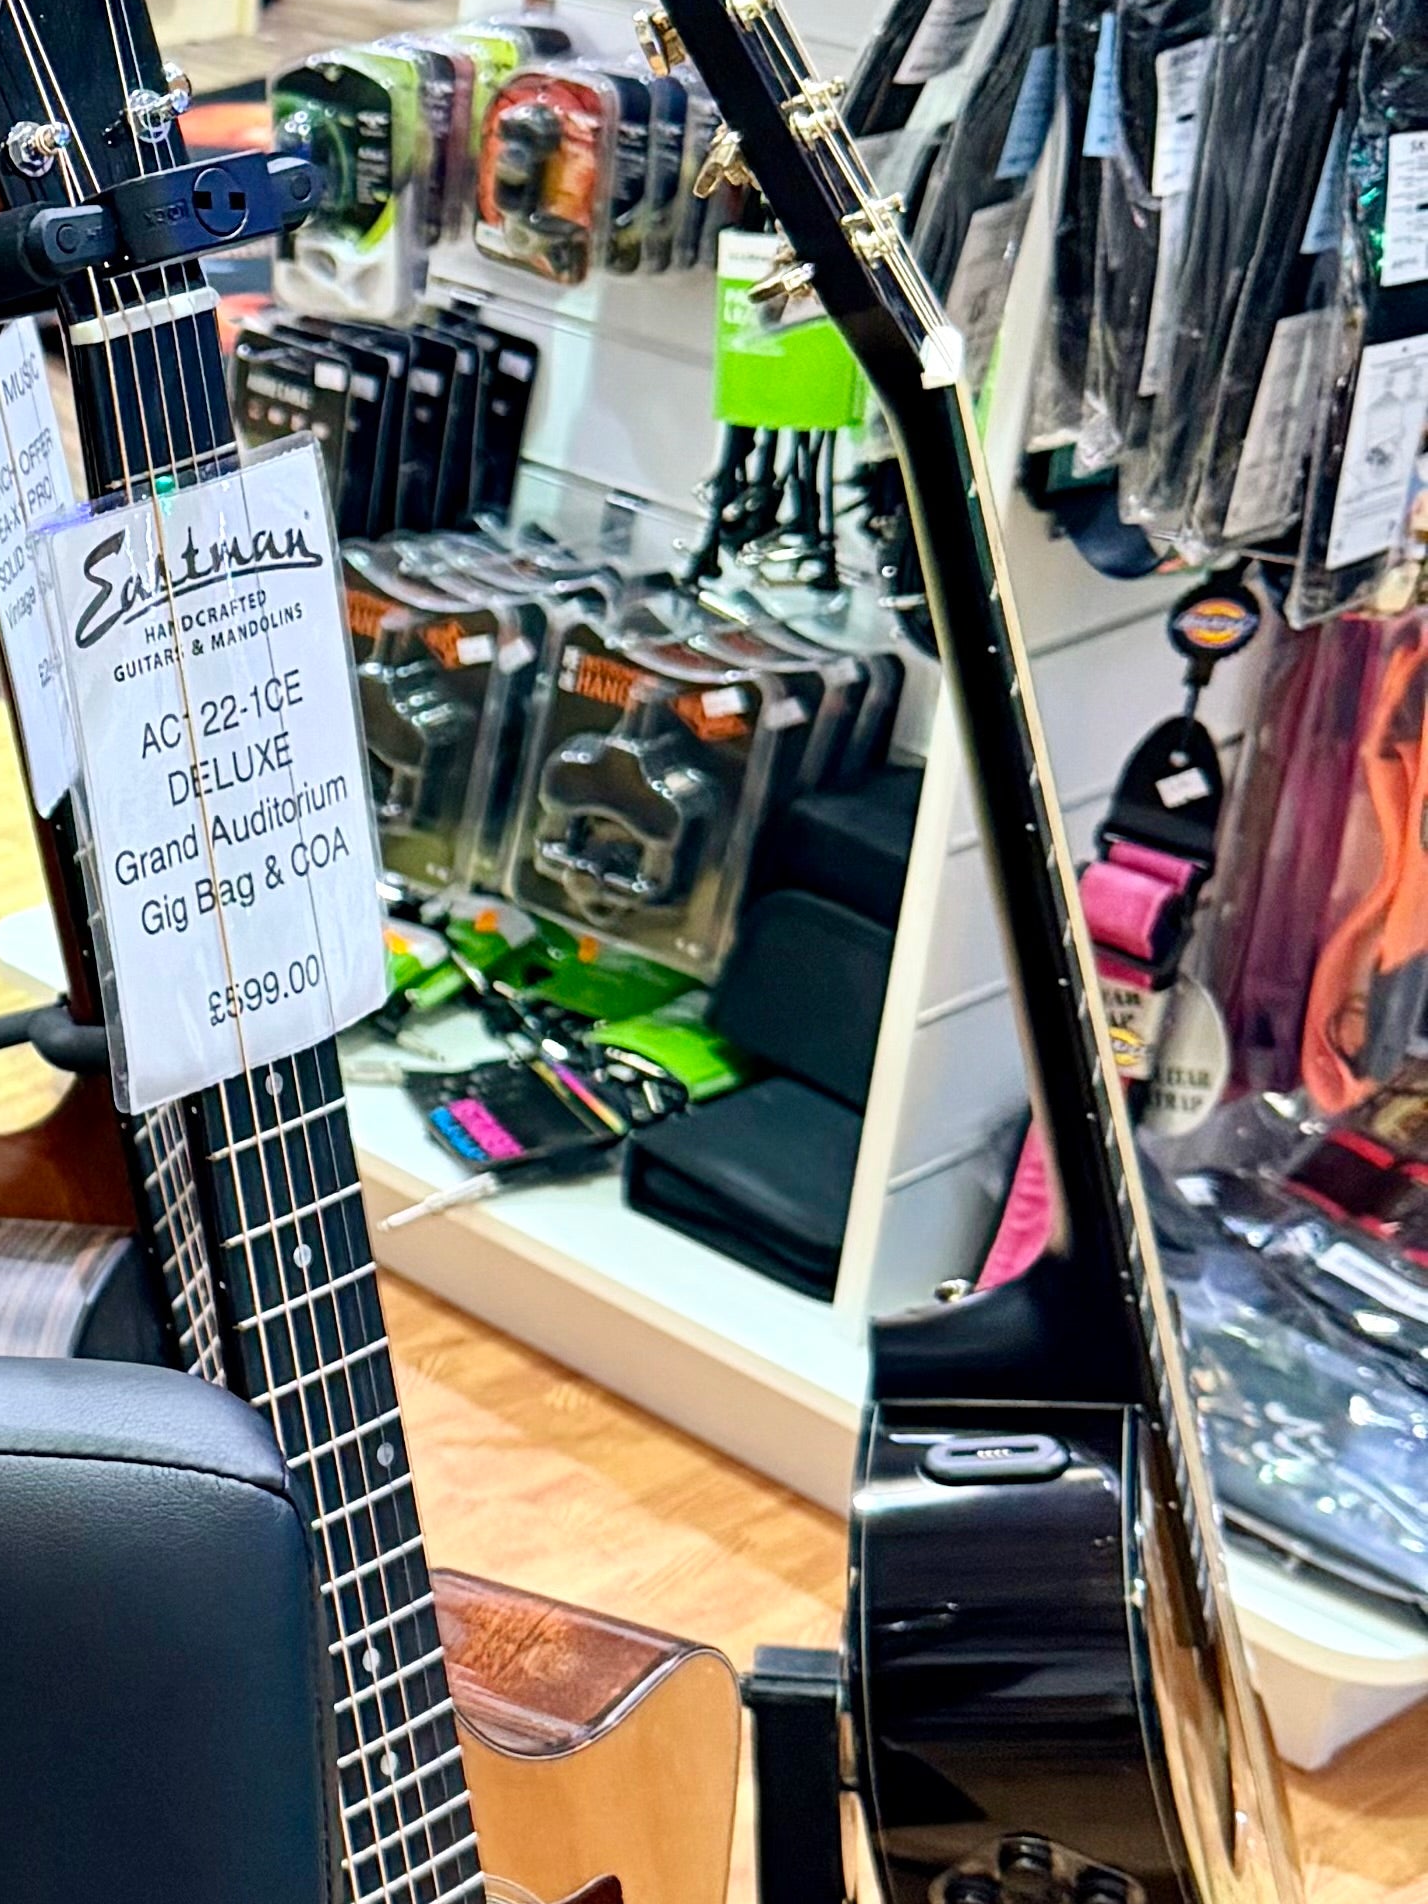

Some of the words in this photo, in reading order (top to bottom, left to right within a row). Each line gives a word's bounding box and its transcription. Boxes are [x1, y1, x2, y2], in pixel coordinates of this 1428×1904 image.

[1, 352, 42, 408] MUSIC
[18, 427, 54, 476] OFFER
[27, 475, 54, 515] PRO
[75, 525, 323, 649] Eastman
[144, 589, 267, 645] HANDCRAFTED
[191, 638, 205, 657] &
[210, 602, 303, 652] MANDOLINS
[141, 668, 304, 760] AC22-1CE
[168, 731, 294, 807] DELUXE
[114, 823, 199, 887] Grand
[210, 774, 348, 851] Auditorium
[141, 894, 189, 935] Gig
[195, 871, 256, 916] Bag
[265, 854, 285, 890] &
[290, 825, 351, 879] COA
[208, 953, 321, 1027] £599.00
